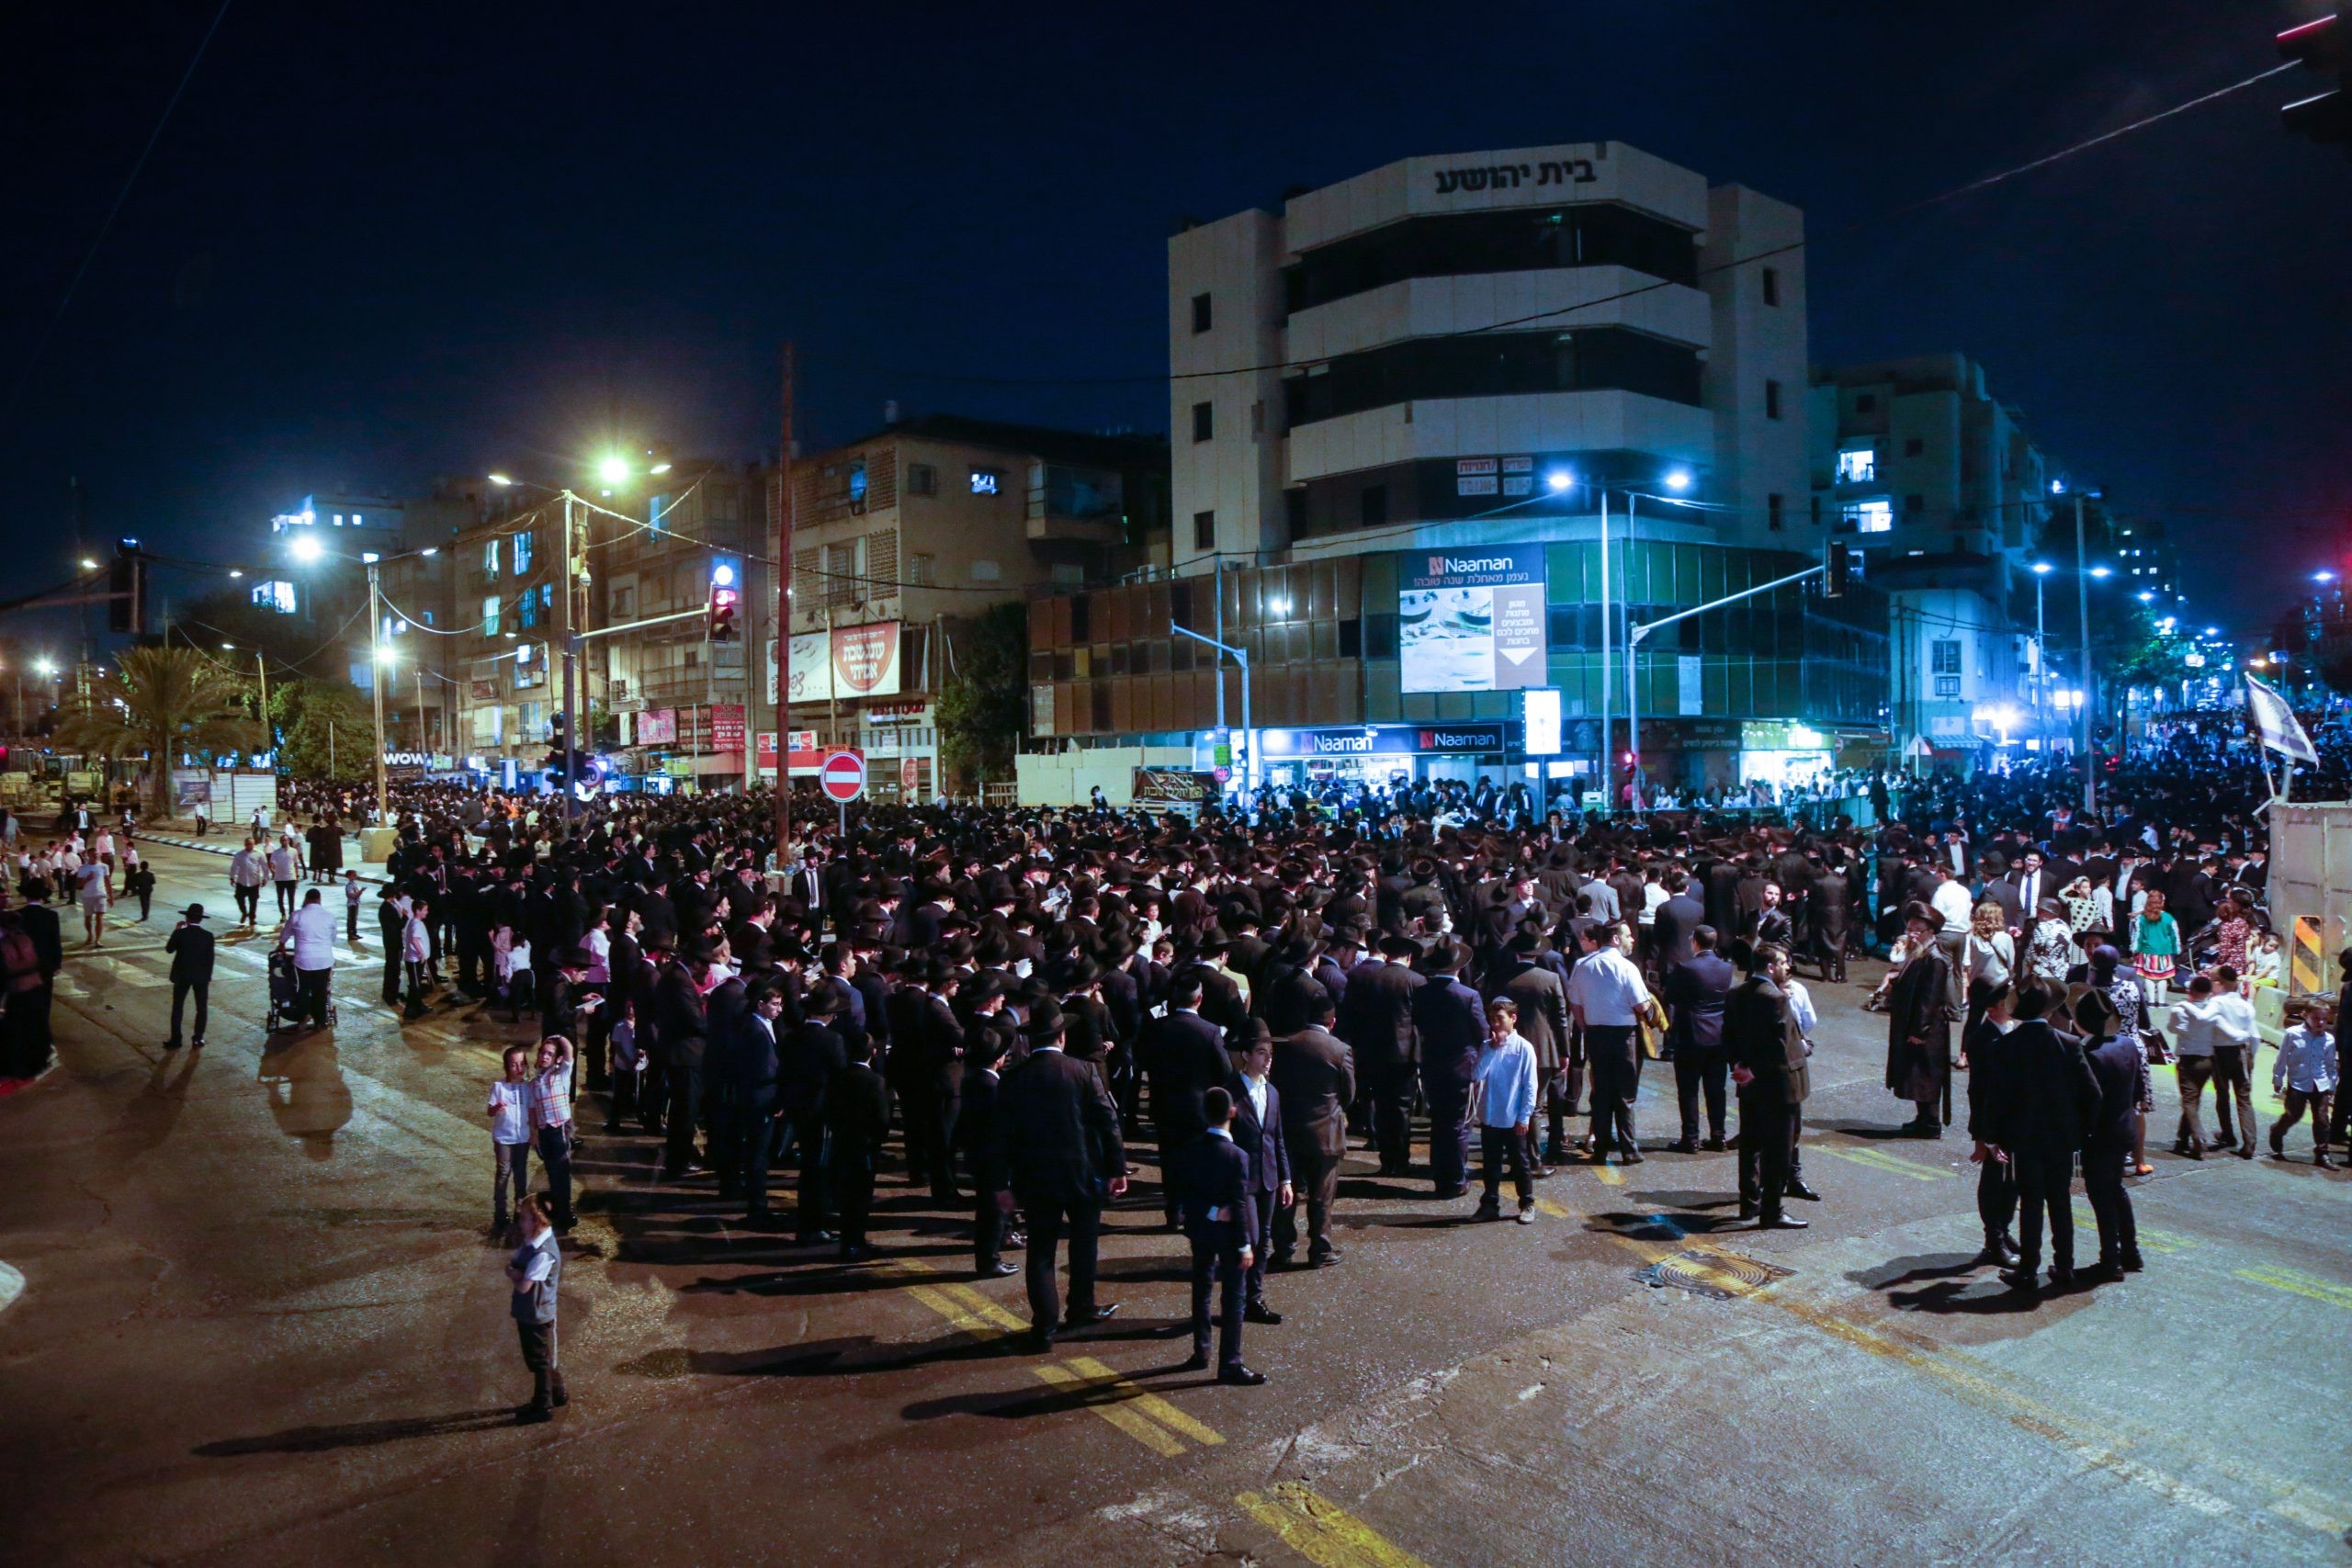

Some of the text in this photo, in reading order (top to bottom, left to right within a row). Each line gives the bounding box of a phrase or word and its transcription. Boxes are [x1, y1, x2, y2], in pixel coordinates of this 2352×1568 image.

[1435, 159, 1597, 194] בית יהושע
[1445, 558, 1512, 573] Naaman
[1414, 572, 1529, 587] נעמן מאחלת שנה טובה!
[843, 643, 864, 661] שבת
[1314, 735, 1373, 751] Naaman
[1435, 733, 1495, 747] Naaman
[382, 752, 427, 765] WOW
